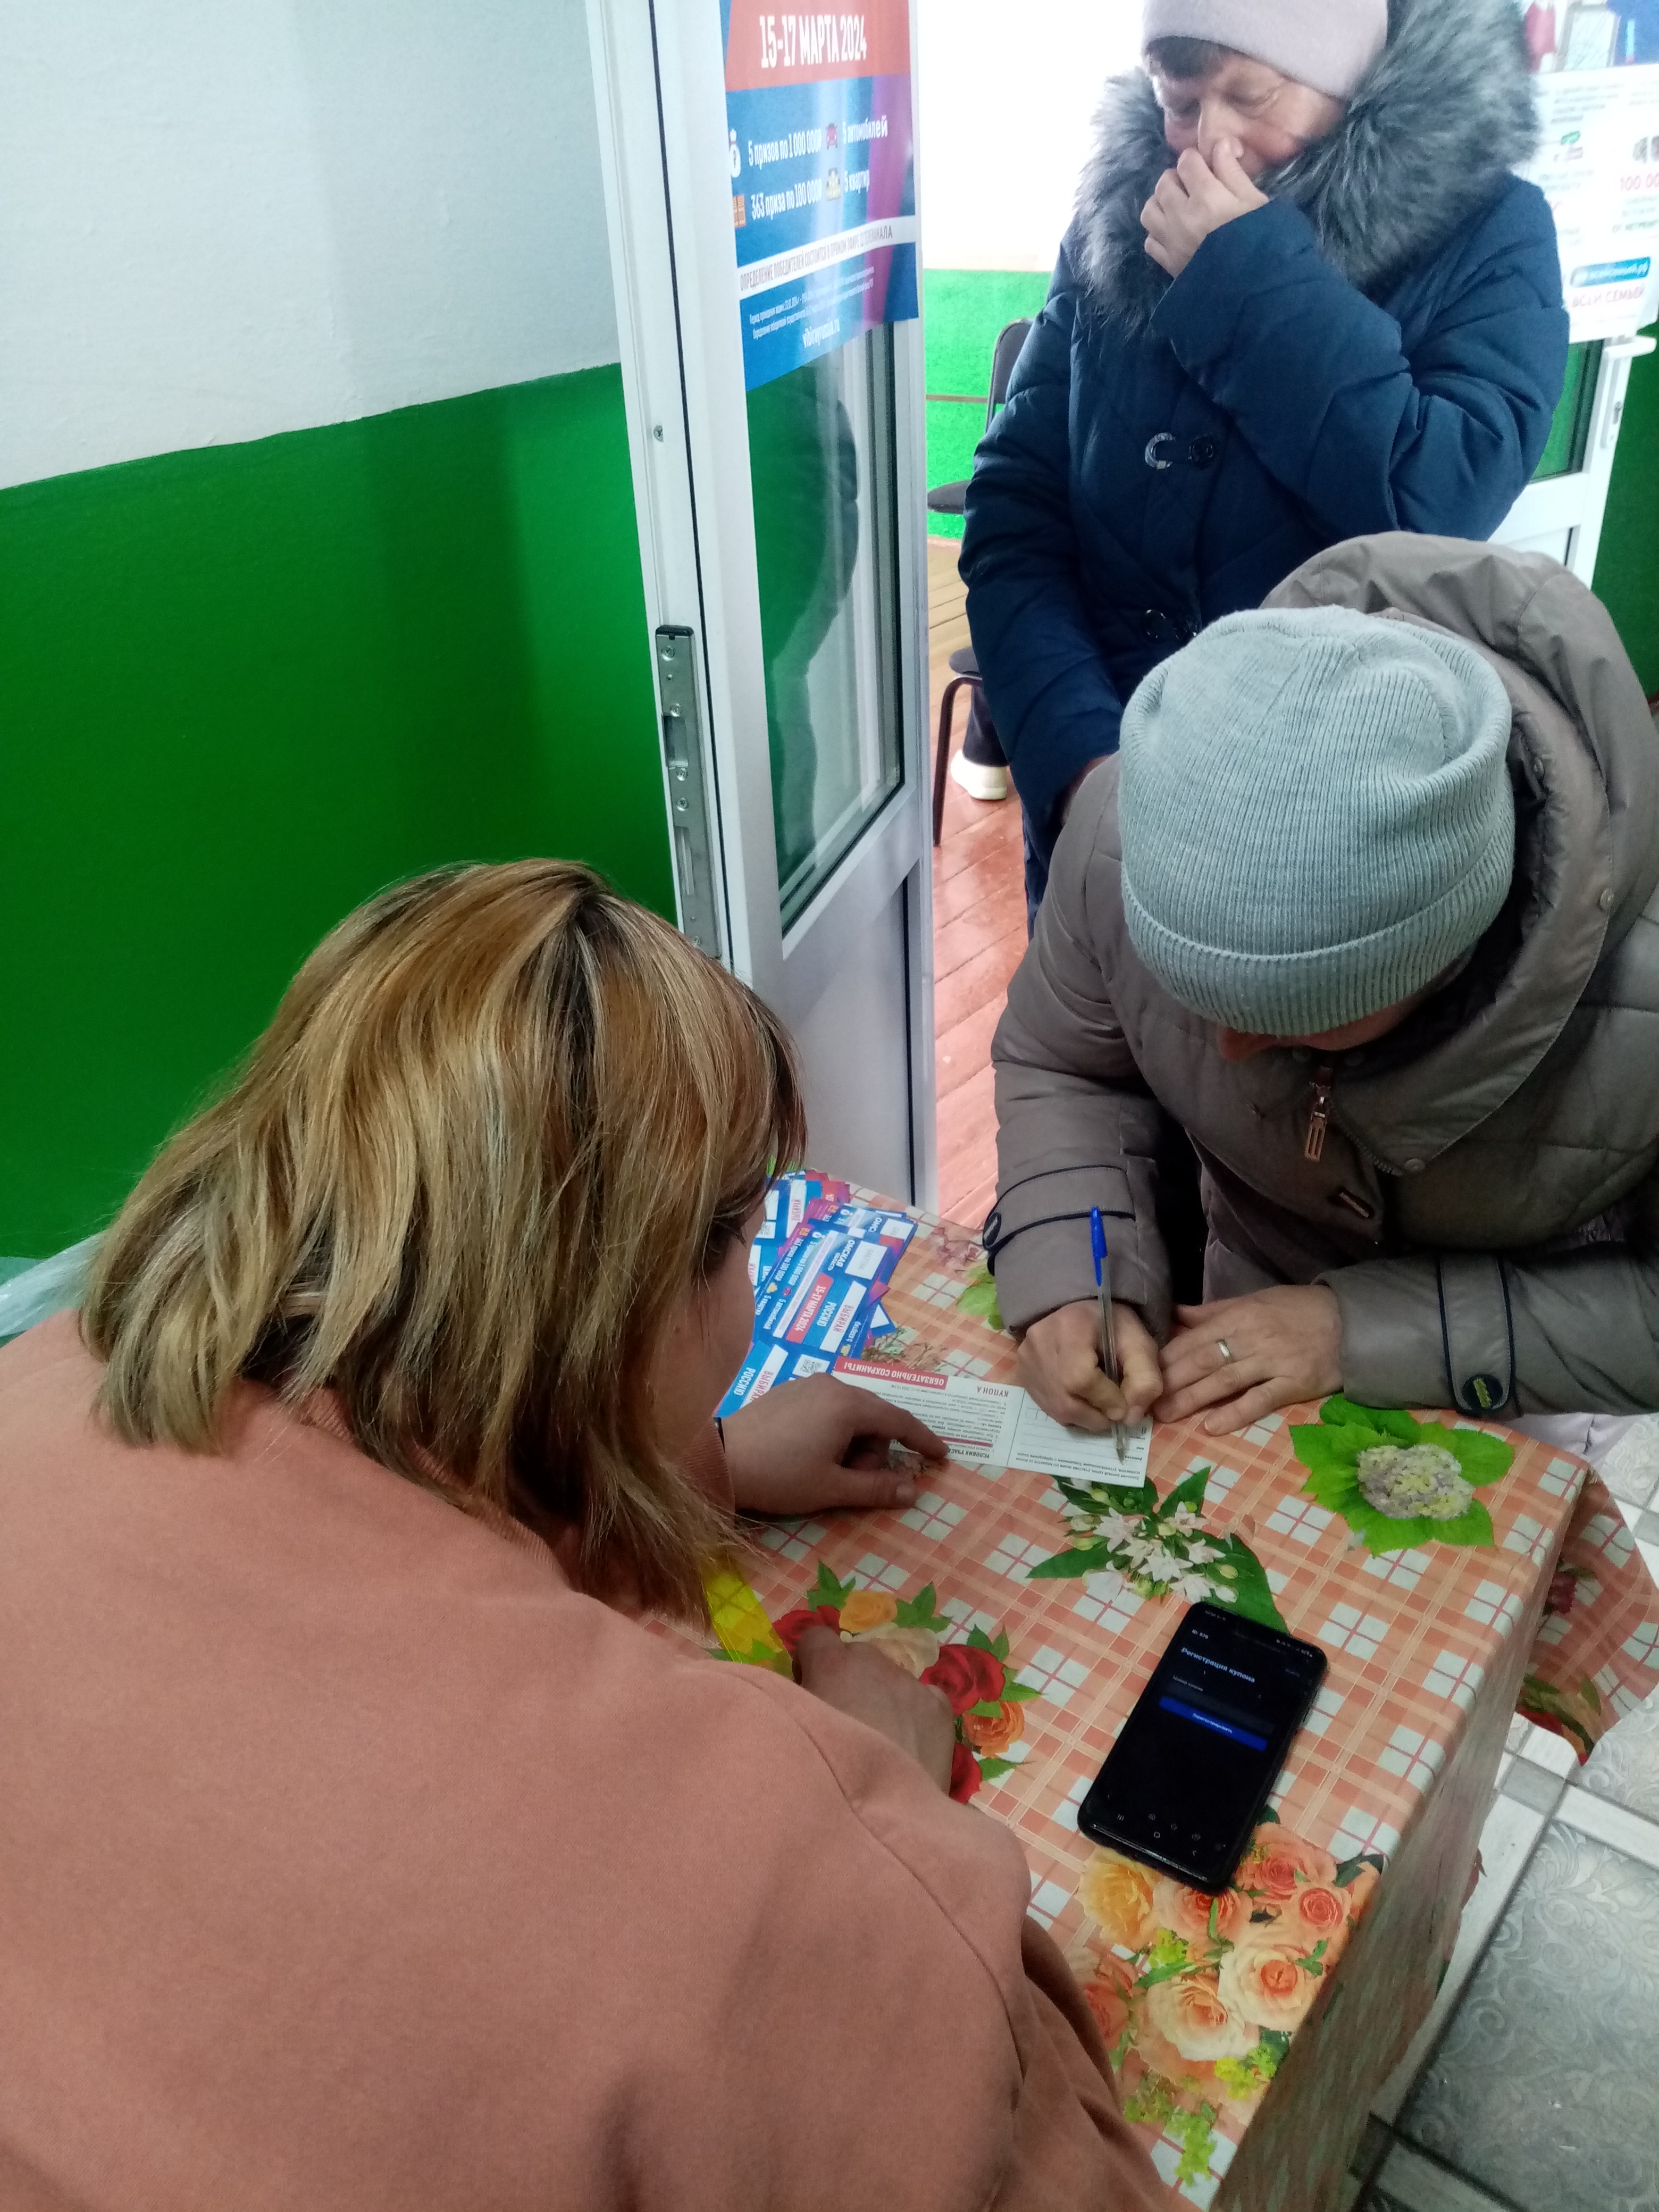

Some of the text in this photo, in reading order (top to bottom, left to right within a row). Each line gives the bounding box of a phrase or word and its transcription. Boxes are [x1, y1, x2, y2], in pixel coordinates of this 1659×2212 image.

[759, 13, 867, 69] 15-17 МАРТА 2024
[842, 114, 889, 145] 5 автомобилей
[748, 140, 754, 167] 5
[755, 140, 780, 171] призов
[780, 139, 788, 160] по
[750, 192, 765, 221] 363
[765, 192, 786, 221] приза
[786, 190, 795, 211] по
[740, 263, 774, 292] ОПРЕДЕЛЕНИЕ
[774, 250, 804, 280] ПОБЕДИТЕЛЕЙ
[826, 1252, 841, 1271] ОБЛАСТЬ
[835, 1238, 856, 1268] ОМСКАЯ
[794, 1285, 826, 1331] 15-17 МАРТА 2024
[816, 1301, 837, 1327] РОССИЮ
[832, 1304, 854, 1334] ВЫБИРАЙ
[732, 1367, 757, 1396] РОССИЮ
[843, 1361, 944, 1386] ОБЯЗАТЕЛЬНО СОХРАНИТЬ!
[983, 1387, 1008, 1397] КУПОН
[1180, 1646, 1255, 1683] Регистрация купона
